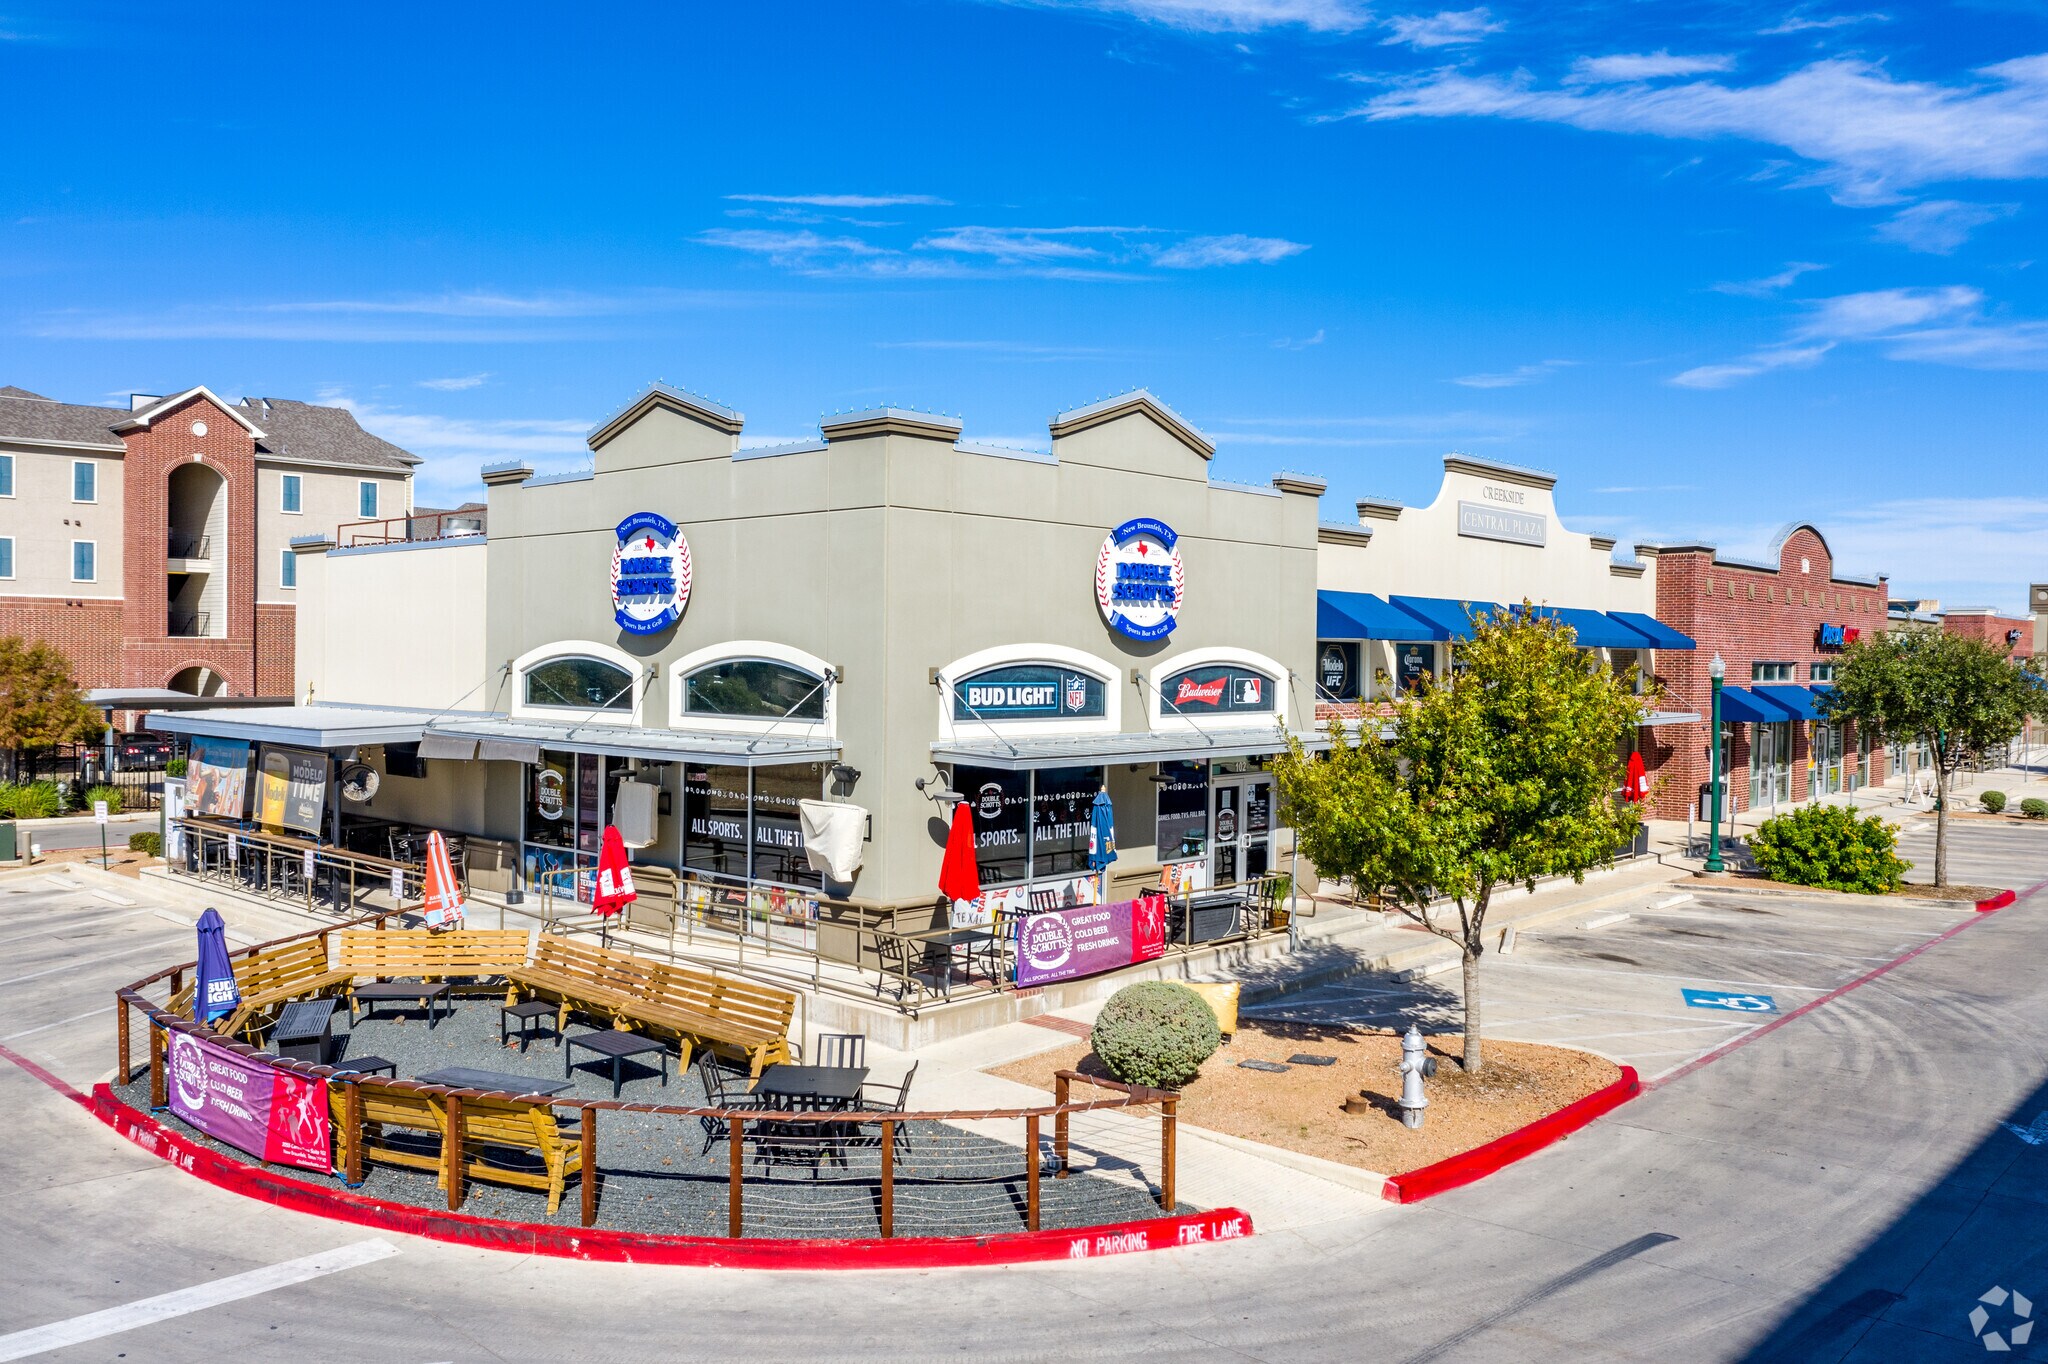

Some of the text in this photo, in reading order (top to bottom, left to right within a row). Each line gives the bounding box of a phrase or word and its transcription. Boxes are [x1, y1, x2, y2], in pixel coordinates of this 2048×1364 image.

[1483, 486, 1524, 504] CREEKSIDE
[1122, 525, 1135, 535] New
[1464, 511, 1542, 537] CENTRAL PLAZA
[1116, 562, 1172, 581] DOUBLE
[1112, 583, 1176, 602] SCHOTTS
[623, 618, 637, 630] Sports
[1126, 624, 1141, 635] Sports
[1157, 623, 1168, 633] Grill
[1322, 657, 1344, 672] Modelo
[1403, 654, 1423, 665] Corona
[1409, 664, 1420, 672] Extra
[1326, 675, 1342, 687] UFC
[969, 687, 1006, 706] BUD
[1069, 691, 1083, 705] NFL
[1178, 683, 1223, 698] Budweiser
[303, 759, 312, 767] IT'S
[1235, 762, 1247, 772] 102
[293, 765, 323, 781] MODELO
[293, 777, 321, 803] TIME
[541, 787, 561, 797] DOUBLE
[540, 795, 563, 806] SCHOTTS
[691, 818, 743, 839] ALL SPORTS.
[1035, 825, 1053, 842] ALL
[1054, 823, 1072, 839] THE
[1073, 821, 1091, 837] TIM
[757, 827, 773, 844] ALL
[774, 828, 793, 847] THE
[980, 828, 1021, 848] SPORTS.
[1072, 911, 1111, 926] GREAT FOOD
[1033, 930, 1063, 943] DOUBLE
[1074, 925, 1108, 939] COLD BEER
[1031, 939, 1067, 954] SCHOTTS
[1077, 937, 1119, 952] FRESH DRINKS
[209, 1061, 248, 1085] GREAT FOOD
[226, 1085, 244, 1101] BEER
[229, 1105, 253, 1122] DRINKS
[180, 1152, 195, 1171] LANE
[1179, 1218, 1243, 1243] FIRE LANE
[1071, 1231, 1148, 1259] NO PARKING
